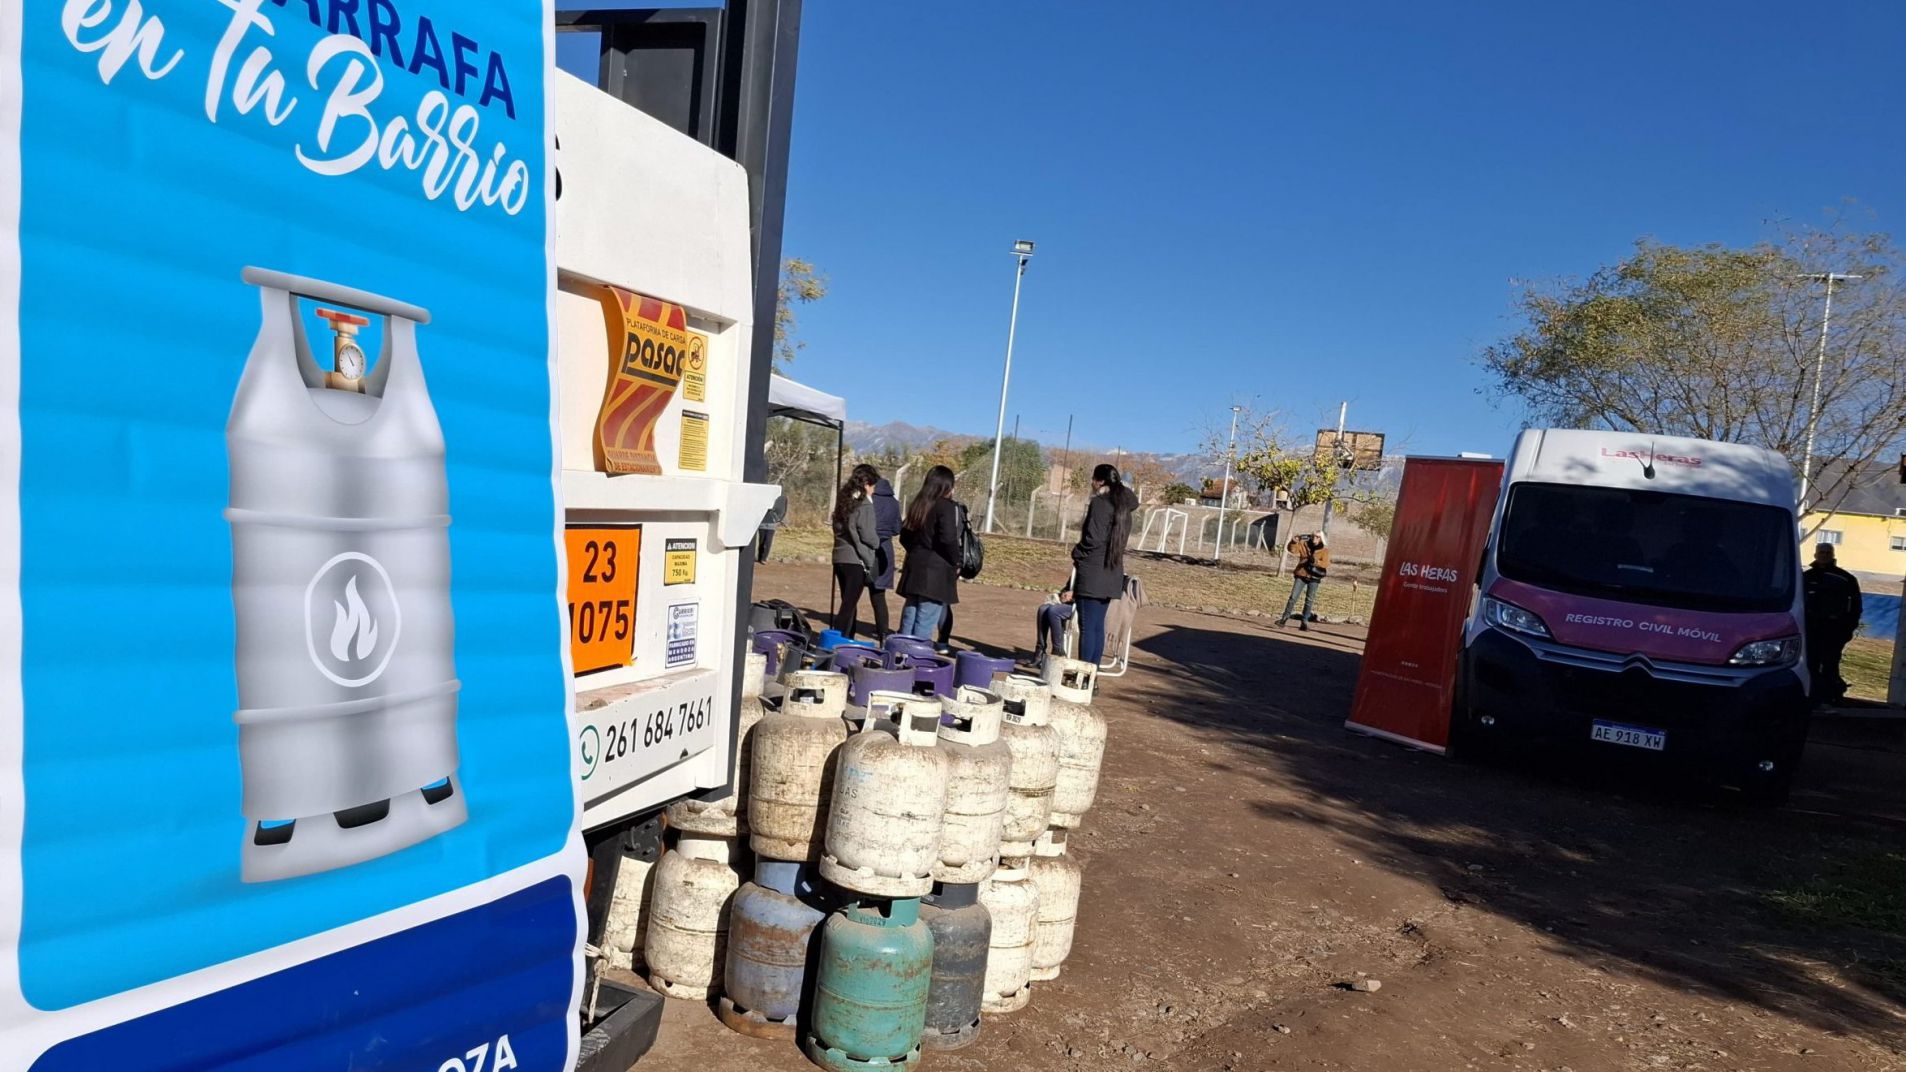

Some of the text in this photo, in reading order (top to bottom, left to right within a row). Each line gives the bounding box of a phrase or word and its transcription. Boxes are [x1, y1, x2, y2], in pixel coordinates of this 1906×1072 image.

[61, 0, 184, 85] en
[204, 0, 298, 126] Tu
[296, 34, 529, 215] Barrio
[626, 317, 686, 344] PLATAFORMA DE CARGA
[582, 540, 617, 583] 23
[1399, 561, 1458, 582] LAS HERAS
[1565, 613, 1722, 643] REGISTRO CIVIL MÓVIL
[604, 695, 712, 763] 261 684 7661
[1595, 727, 1611, 740] AE
[1616, 730, 1640, 745] 918
[1644, 735, 1662, 748] XW
